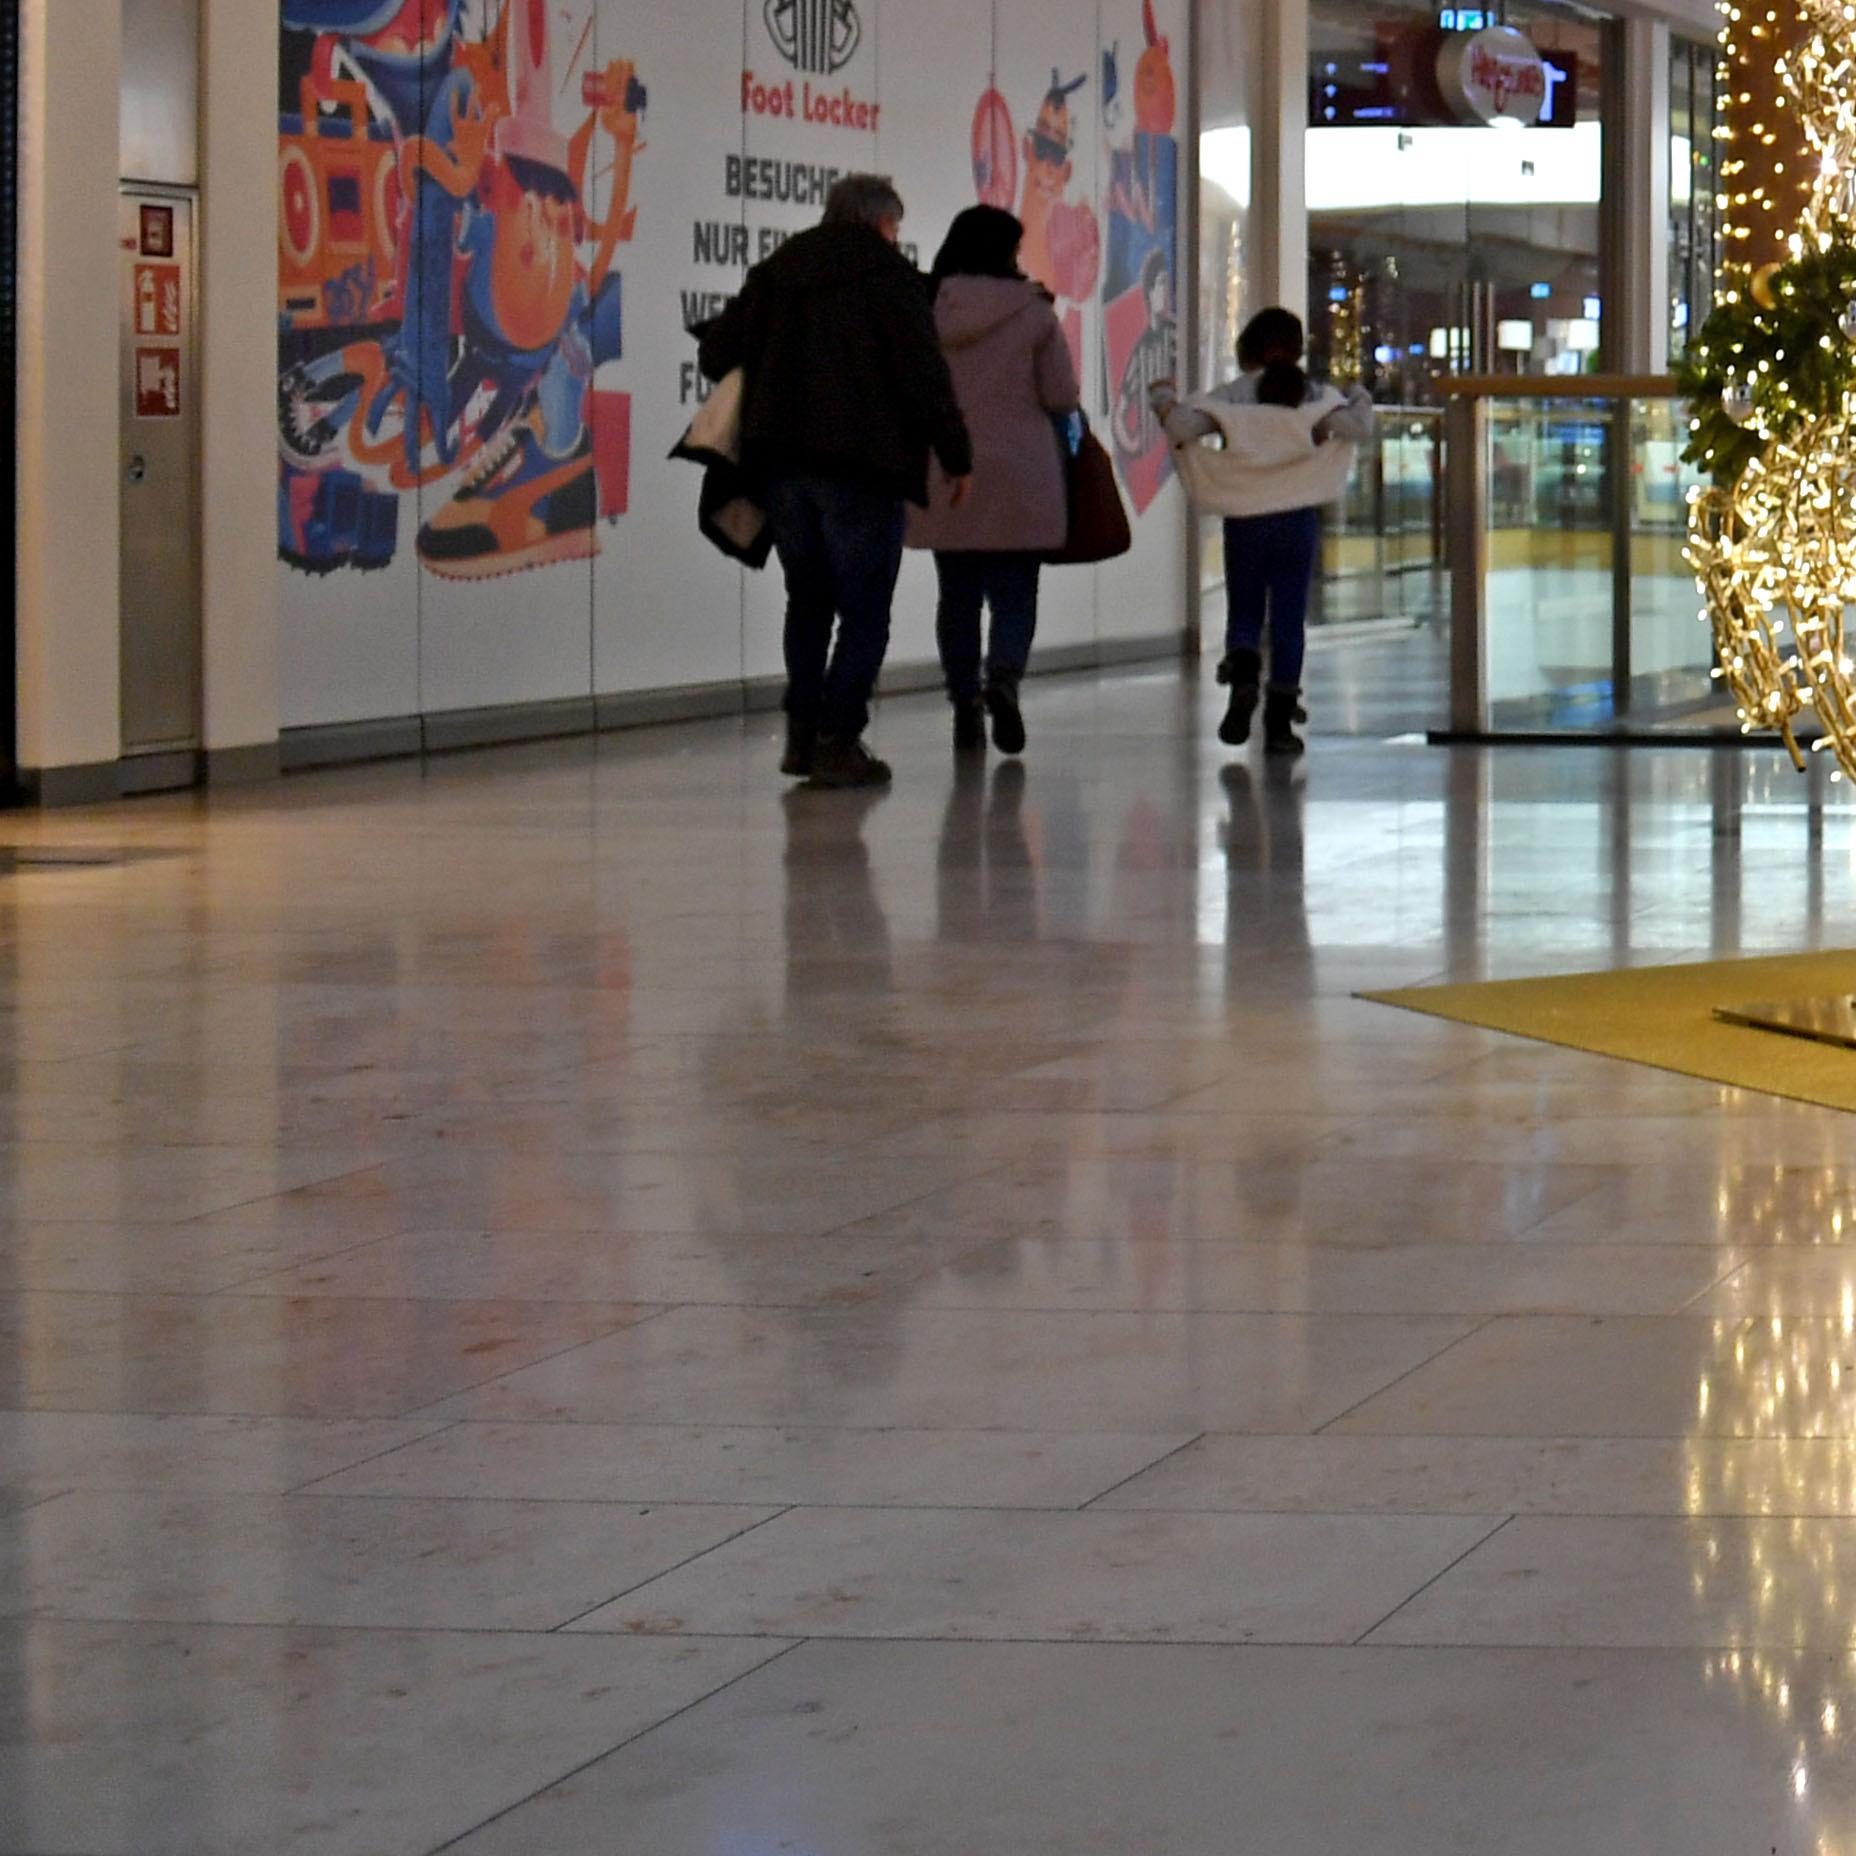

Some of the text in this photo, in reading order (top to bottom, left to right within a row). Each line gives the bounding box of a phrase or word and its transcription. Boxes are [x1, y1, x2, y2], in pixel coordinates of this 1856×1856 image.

[741, 71, 881, 131] Foot Locker
[693, 221, 749, 267] NUR
